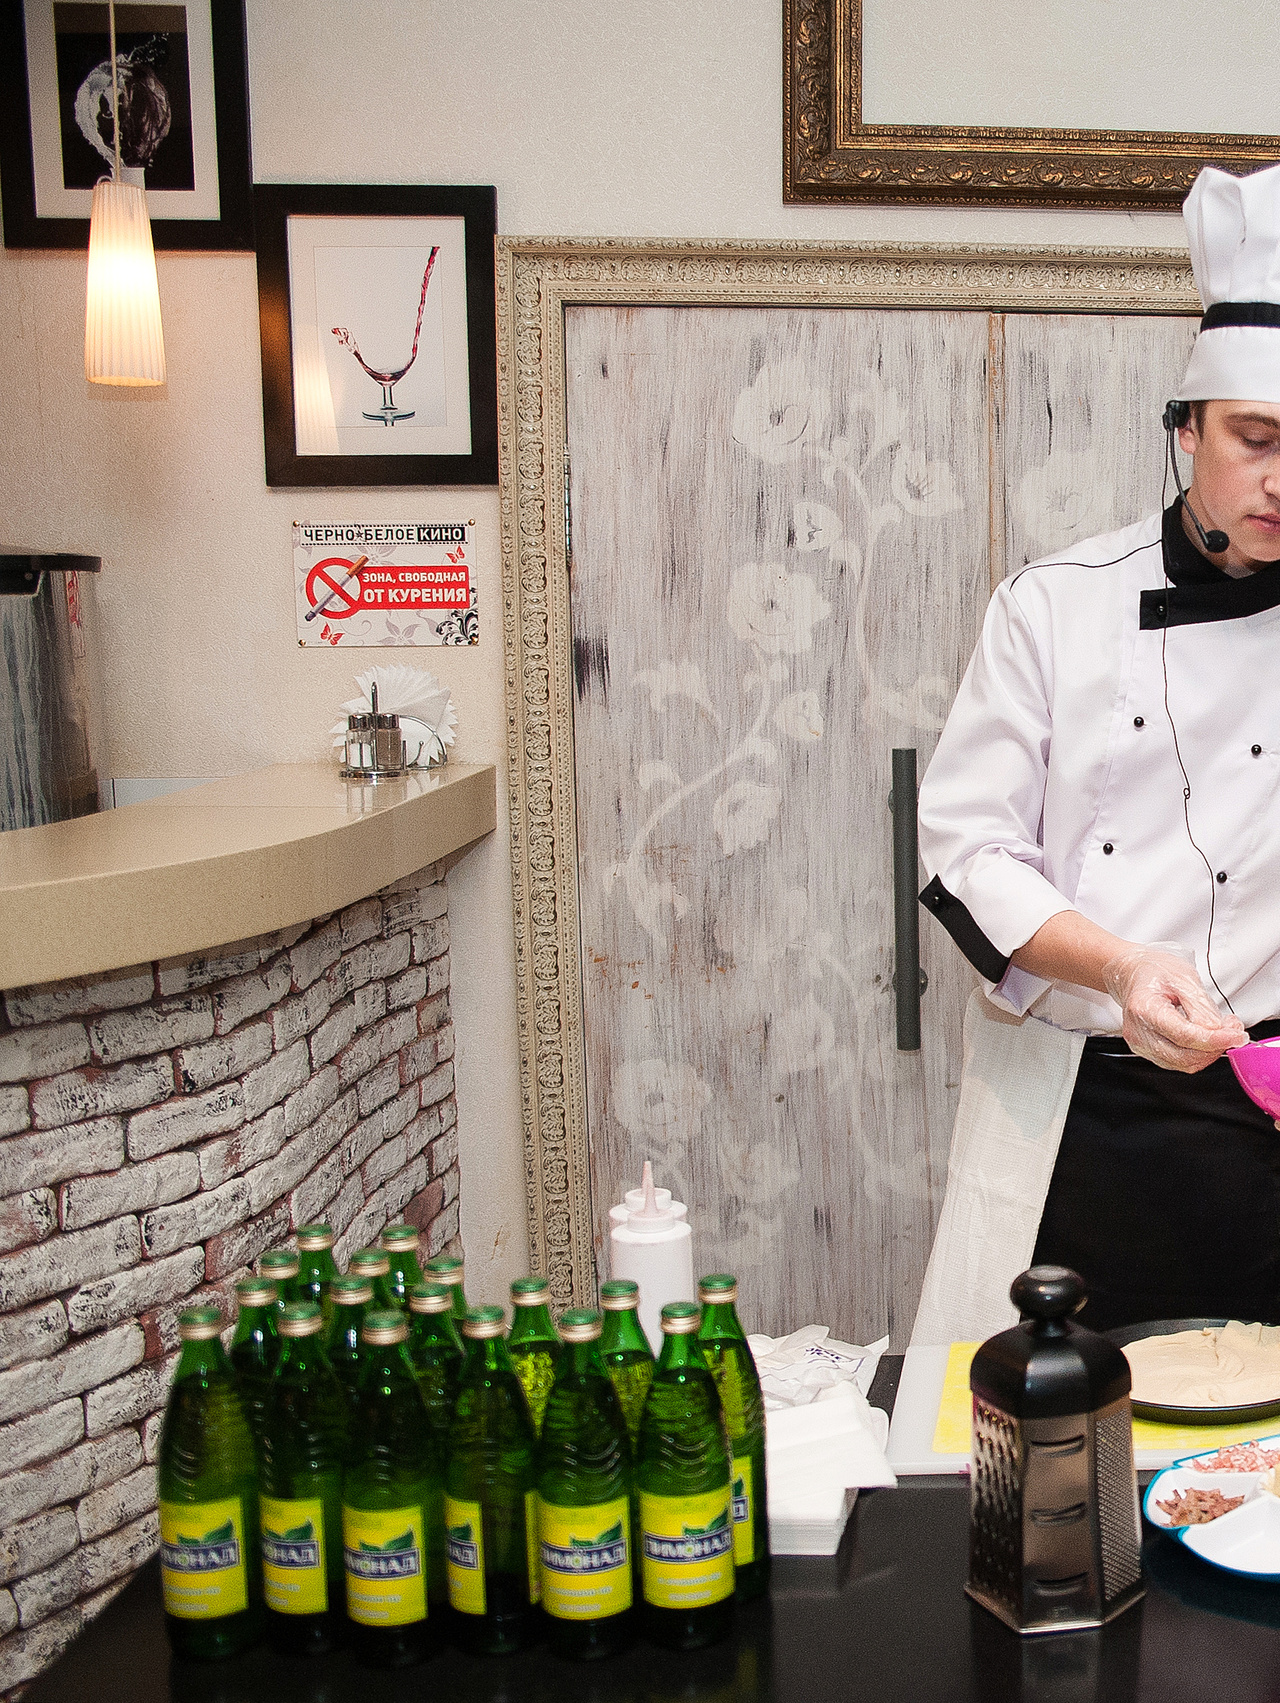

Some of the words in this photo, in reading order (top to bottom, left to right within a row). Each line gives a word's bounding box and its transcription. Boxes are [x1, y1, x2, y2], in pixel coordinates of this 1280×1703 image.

[304, 529, 354, 541] ЧЕРНО
[364, 529, 414, 540] БЕЛОЕ
[418, 528, 463, 540] КИНО
[363, 573, 396, 583] ЗОНА,
[398, 572, 466, 583] СВОБОДНАЯ
[363, 589, 384, 602] ОТ
[388, 588, 467, 602] КУРЕНИЯ
